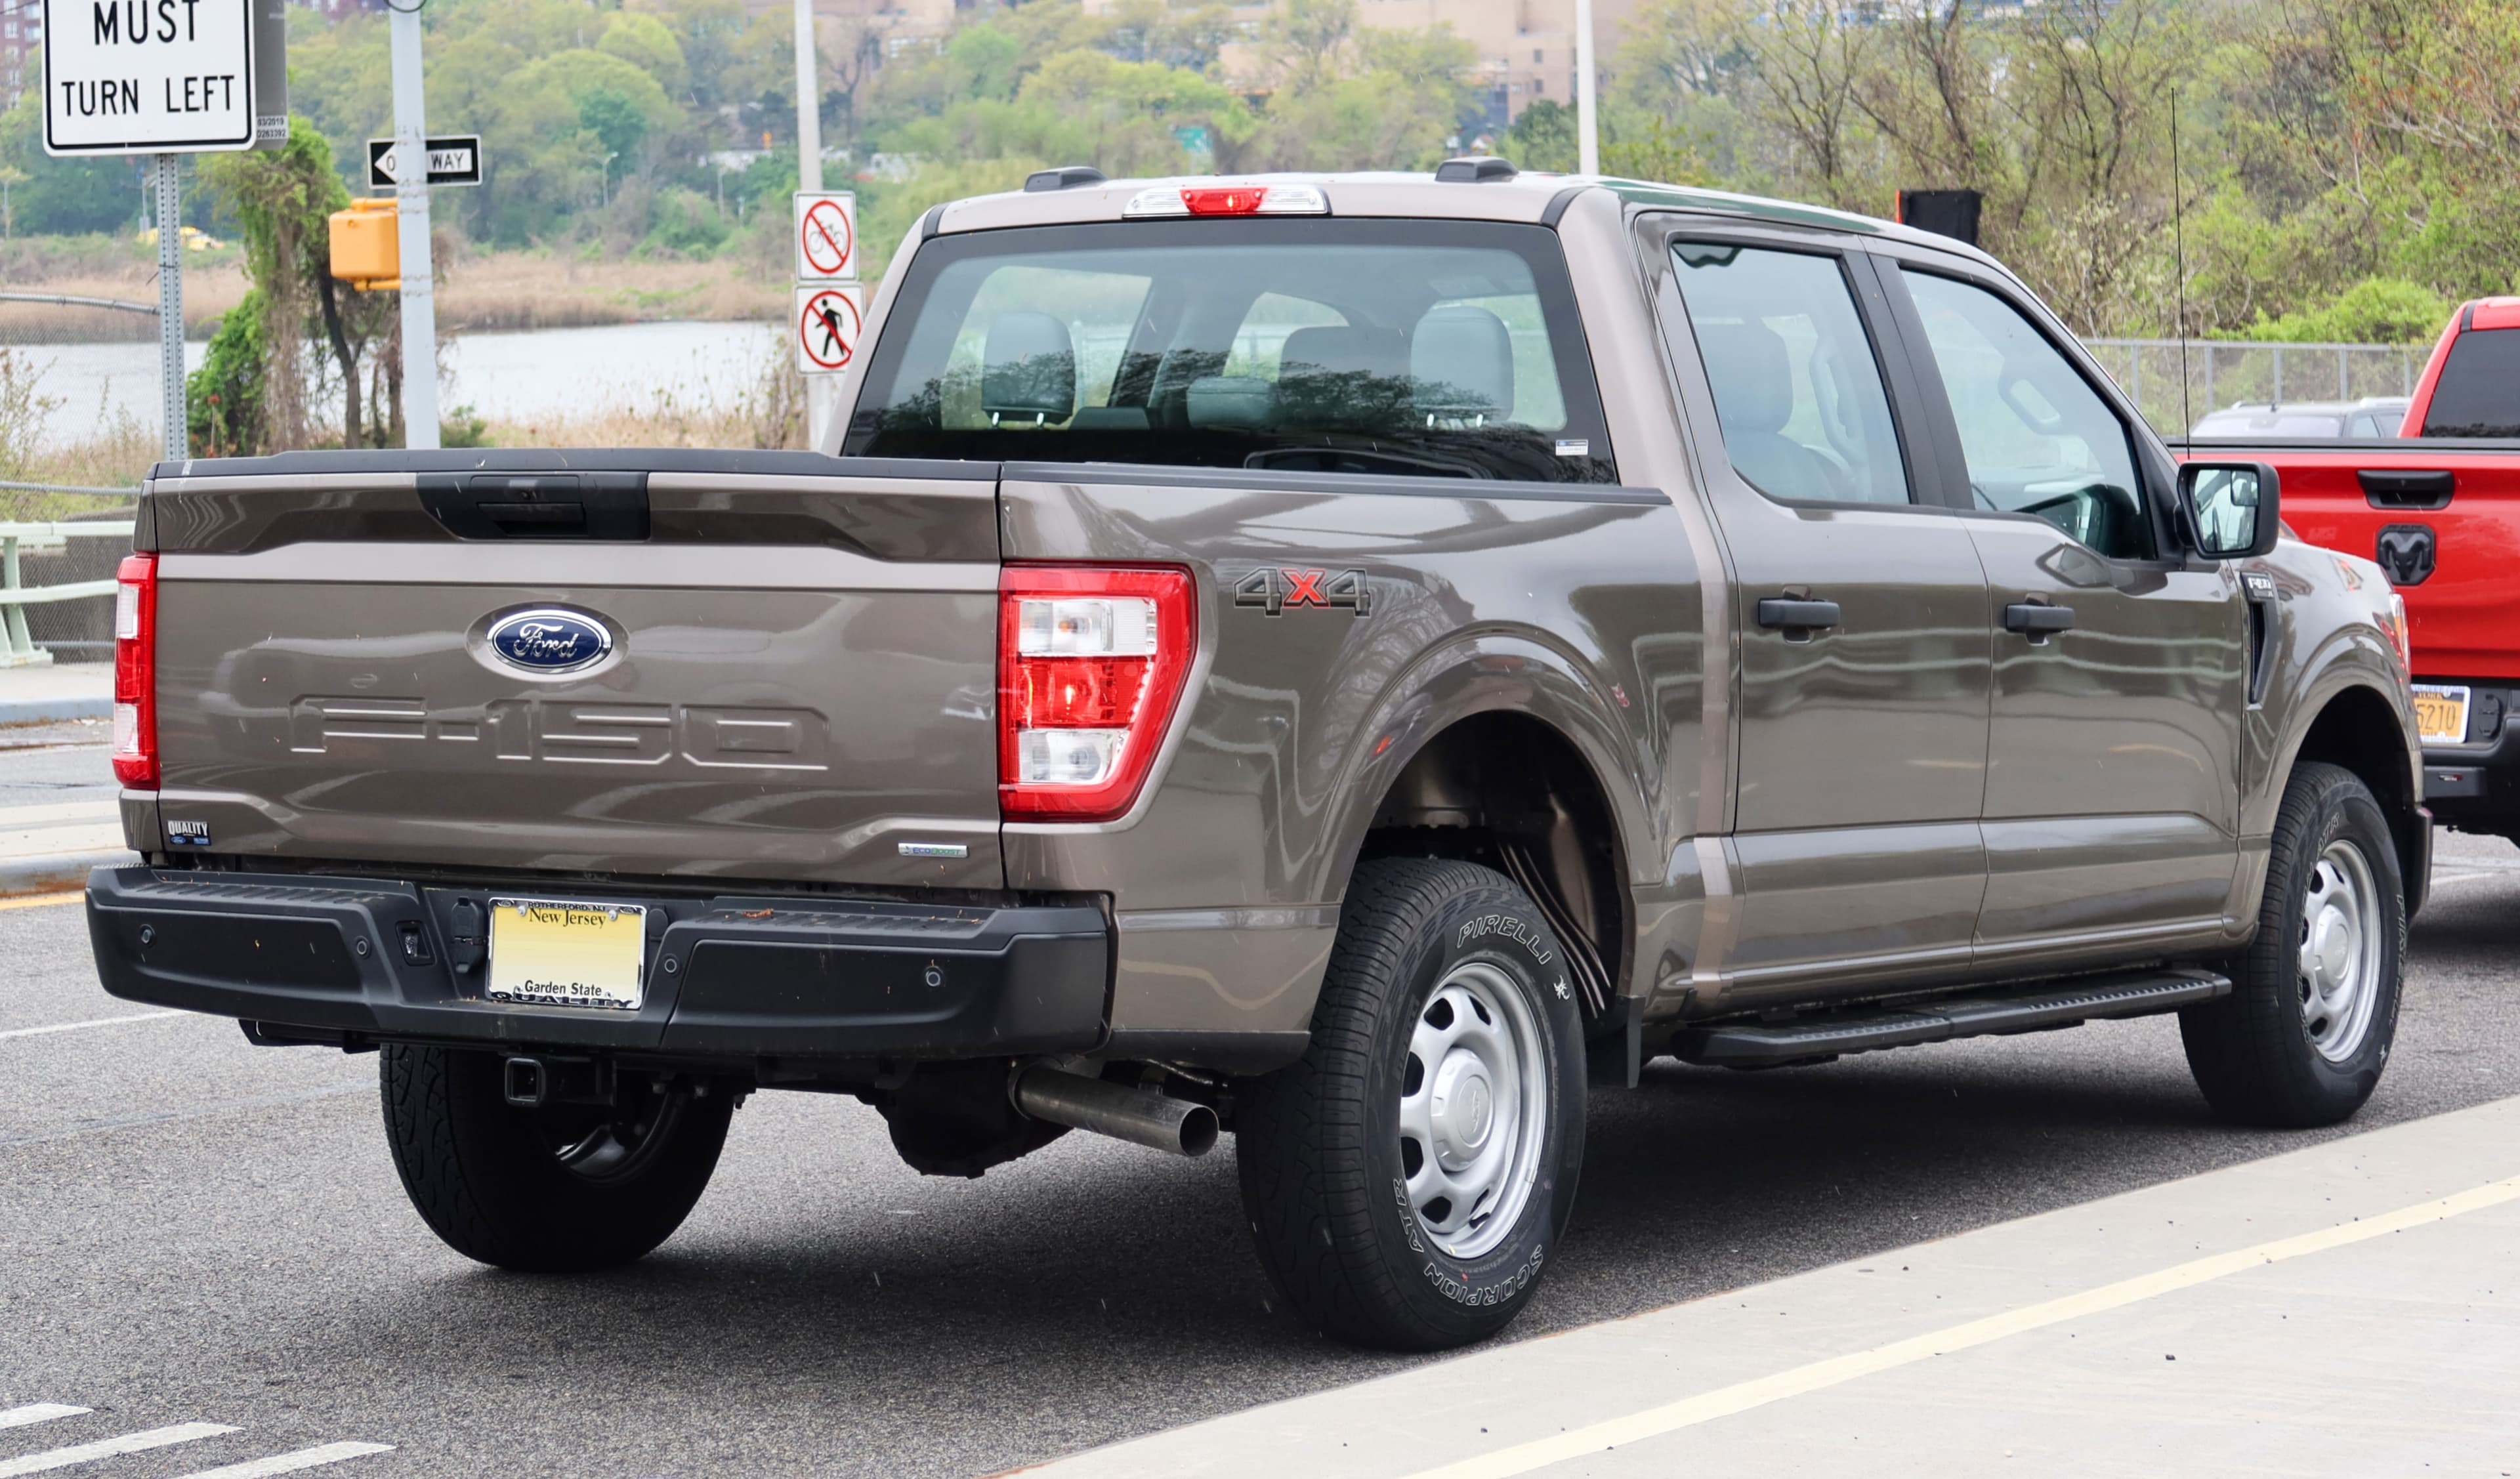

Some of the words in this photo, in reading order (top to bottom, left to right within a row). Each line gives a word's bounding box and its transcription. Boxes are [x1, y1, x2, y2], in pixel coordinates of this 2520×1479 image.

[94, 0, 197, 45] MUST
[61, 79, 138, 117] TURN
[165, 75, 234, 113] LEFT
[430, 153, 464, 169] WAY
[513, 622, 580, 659] Ford
[289, 694, 830, 770] F-150
[167, 820, 208, 837] QUALITY
[529, 908, 561, 923] New
[563, 909, 606, 928] Jersey
[1457, 914, 1552, 965] PIRELLI
[492, 991, 635, 1008] QUALITY
[524, 980, 566, 995] Garden
[570, 982, 602, 996] State
[1393, 1178, 1424, 1253] ATR
[1423, 1243, 1544, 1306] SCORPION
